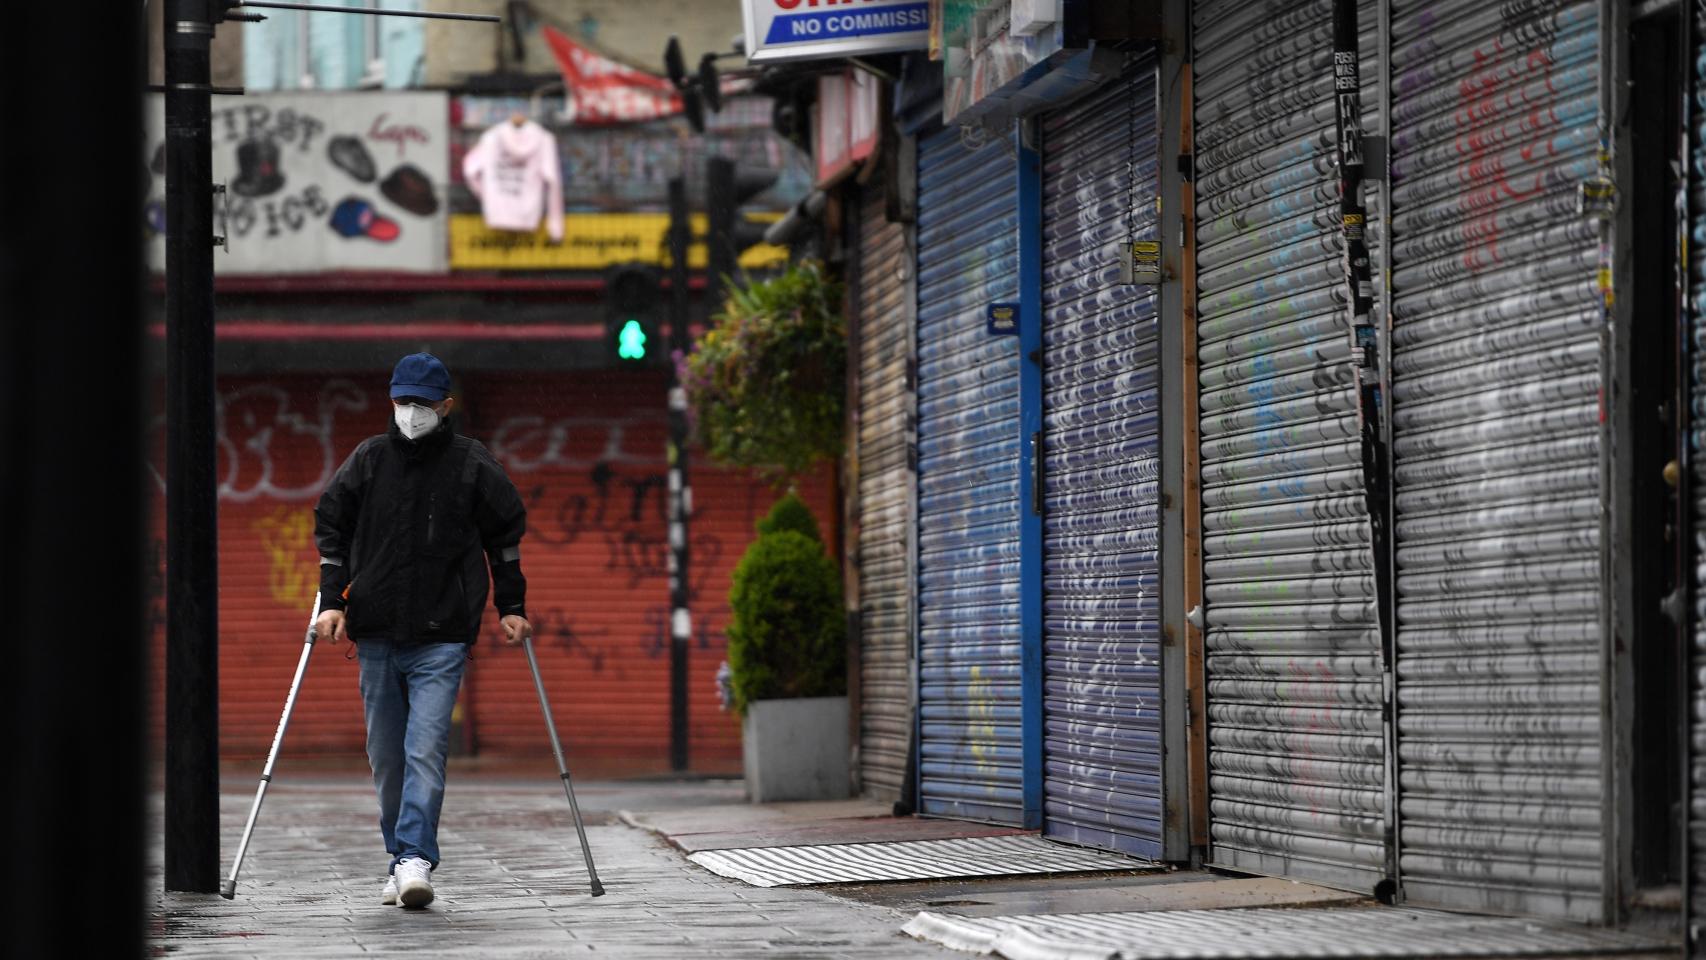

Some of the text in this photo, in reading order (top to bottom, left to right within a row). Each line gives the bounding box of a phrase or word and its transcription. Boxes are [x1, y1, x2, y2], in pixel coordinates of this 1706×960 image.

[791, 9, 927, 35] NO COMMISSI
[1335, 64, 1354, 76] WAS
[1335, 76, 1358, 90] HERE
[212, 104, 325, 151] IRST
